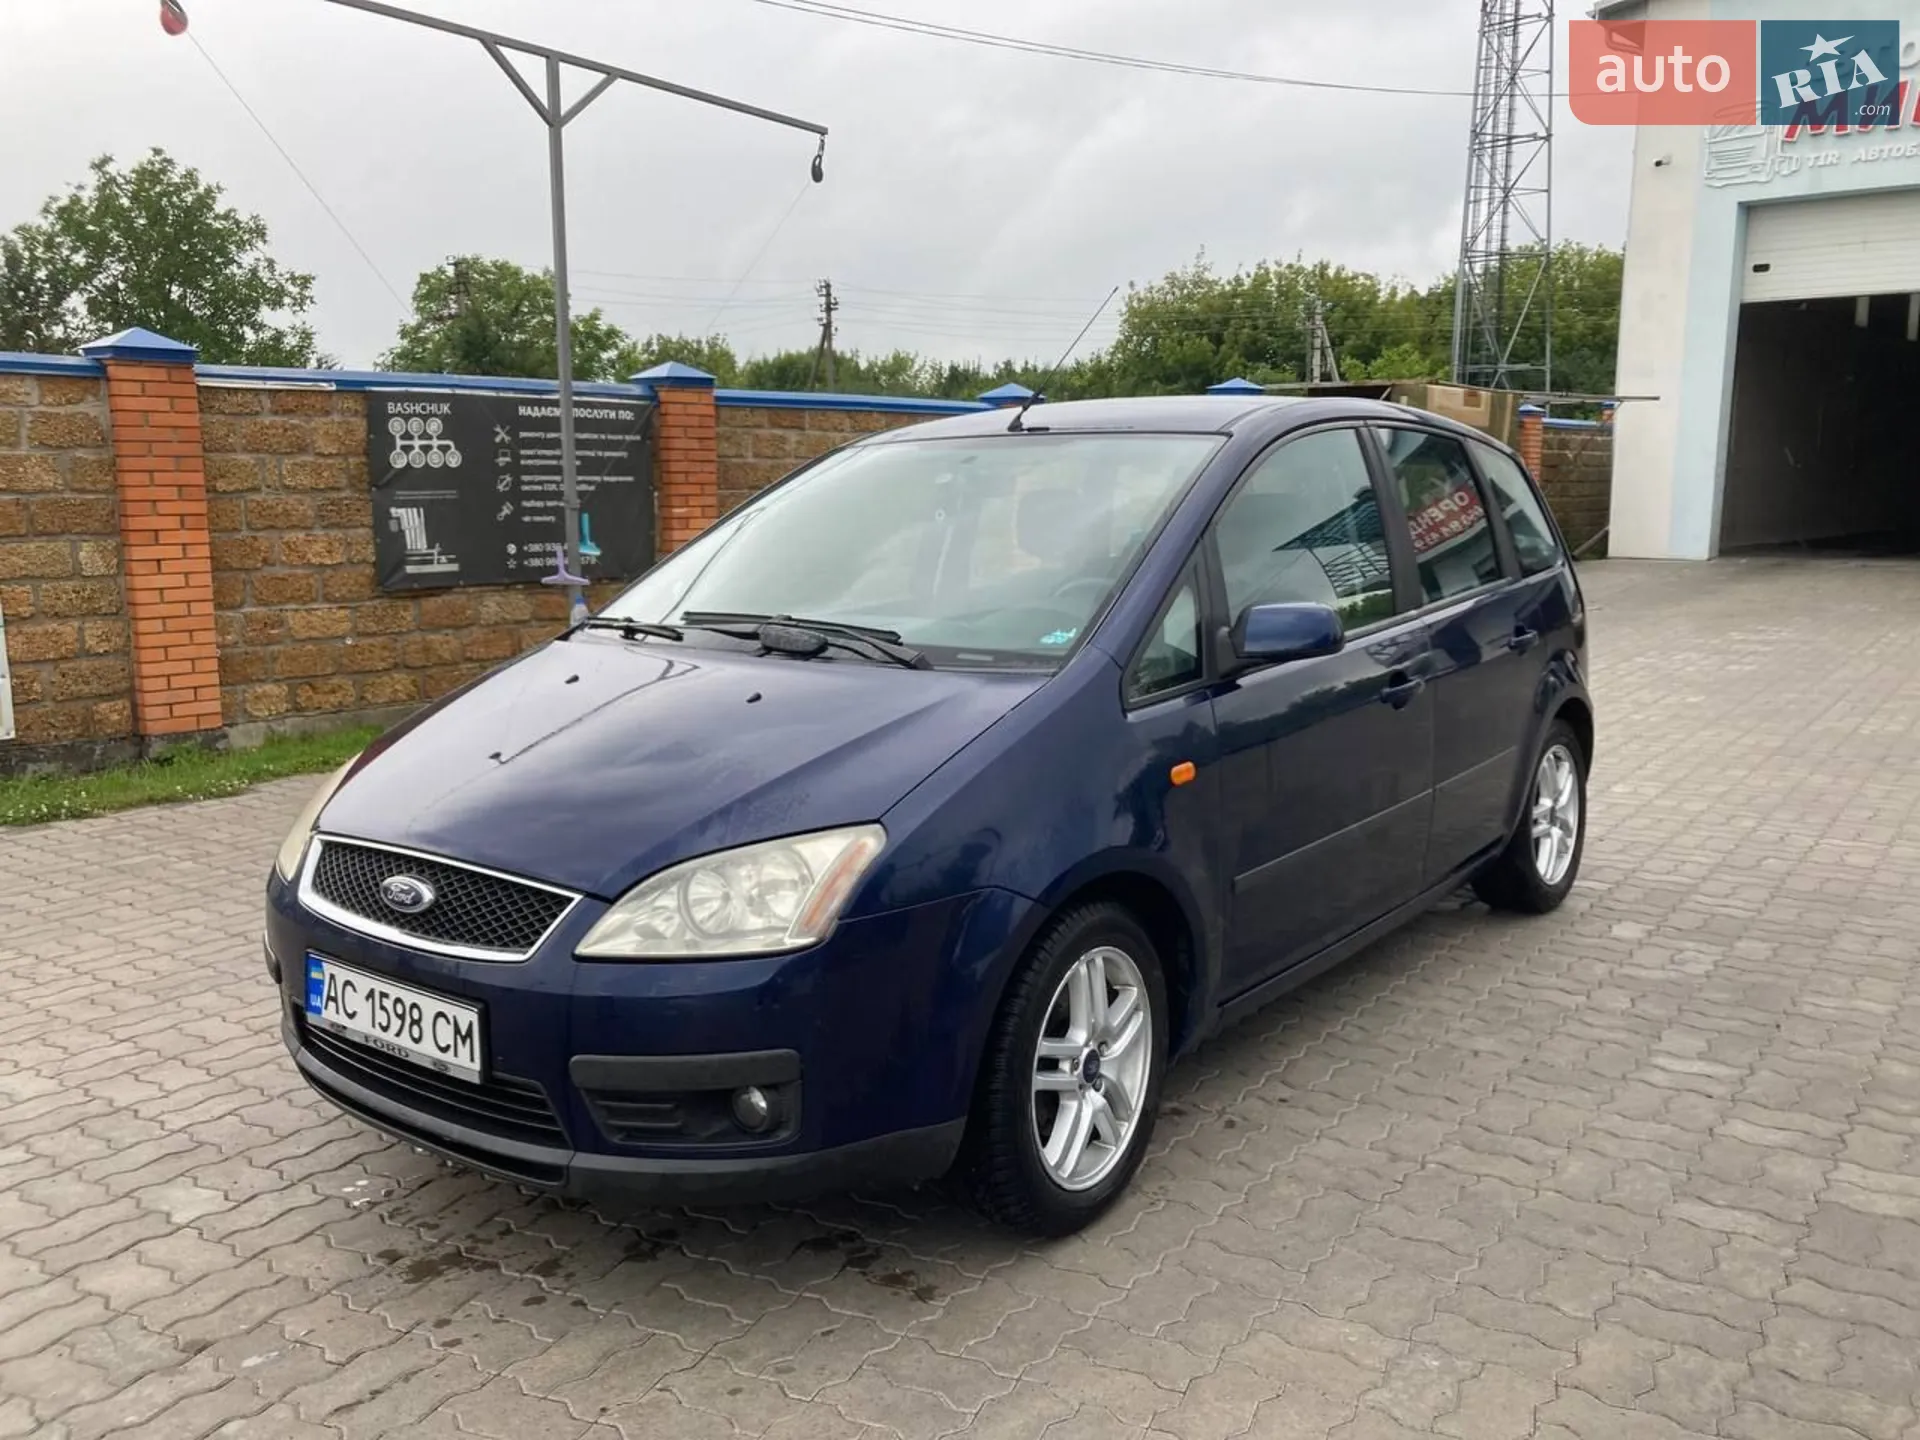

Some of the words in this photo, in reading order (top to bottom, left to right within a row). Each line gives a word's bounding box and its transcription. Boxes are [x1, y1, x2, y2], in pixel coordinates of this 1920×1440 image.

[1783, 77, 1920, 142] МИ
[1852, 141, 1920, 164] АВТОБ
[387, 402, 451, 415] BASHCHUK
[572, 407, 616, 420] ПОСЛУГИ
[387, 881, 415, 904] Ford
[324, 973, 358, 1020] AC
[365, 987, 423, 1044] 1598
[432, 1011, 475, 1063] CM
[364, 1035, 409, 1058] FORD
